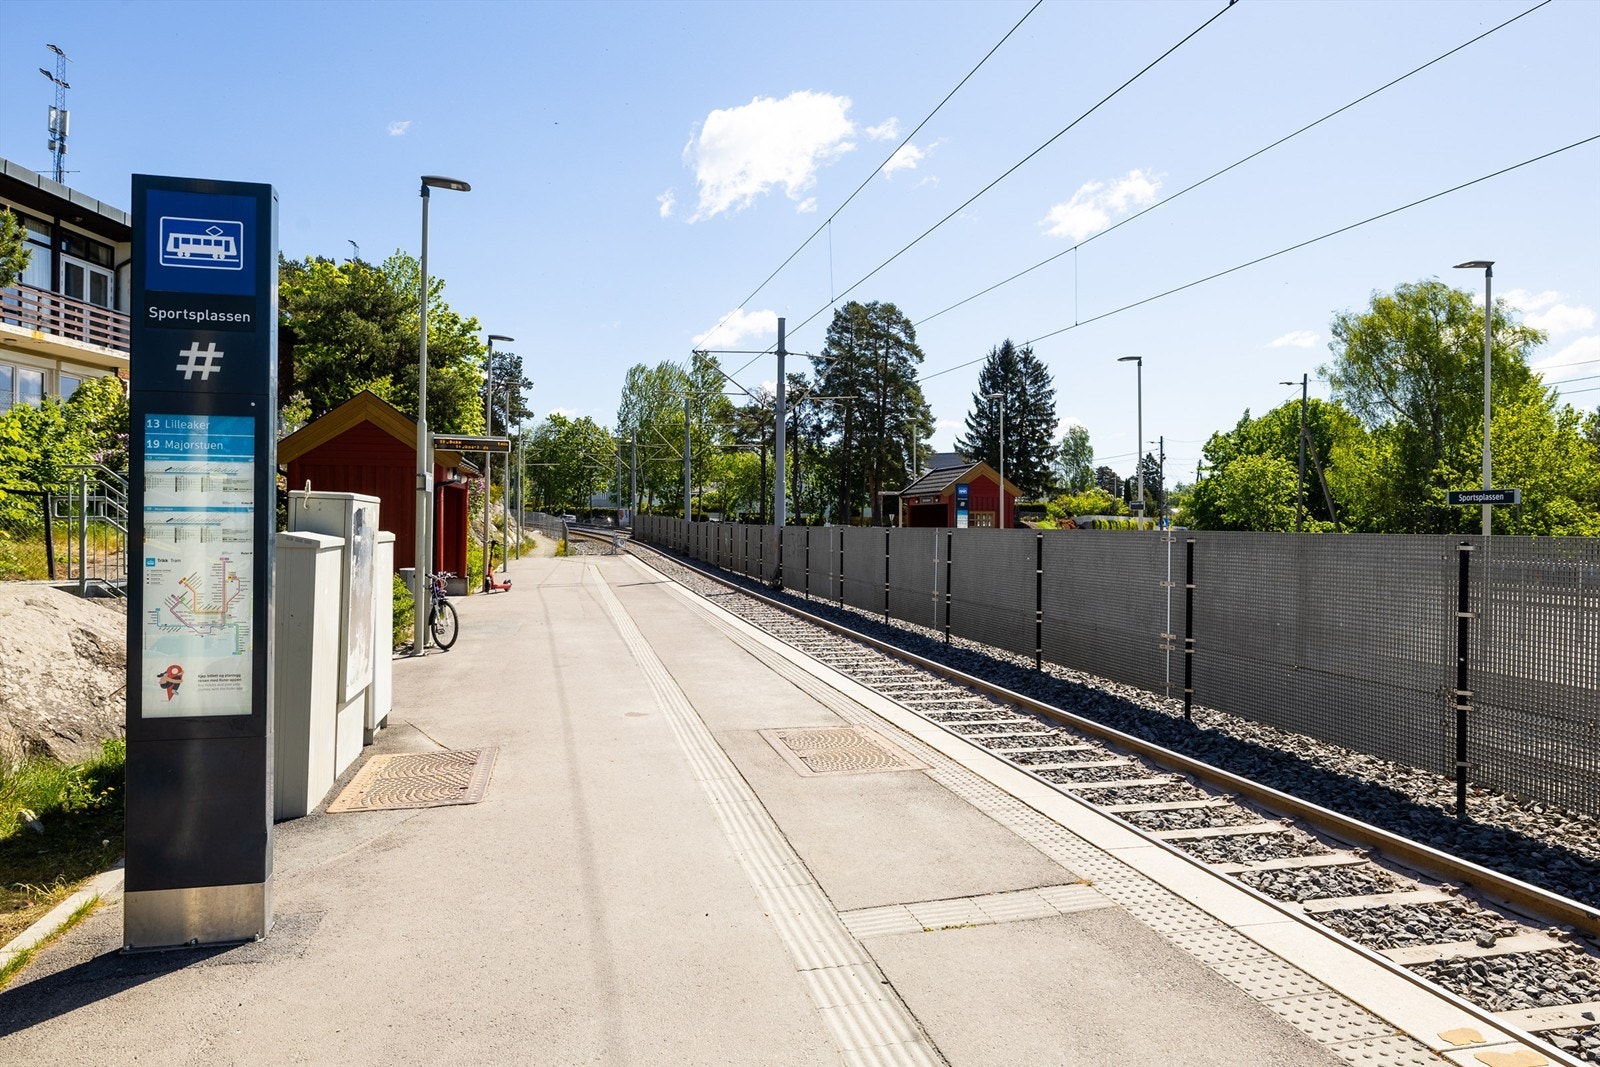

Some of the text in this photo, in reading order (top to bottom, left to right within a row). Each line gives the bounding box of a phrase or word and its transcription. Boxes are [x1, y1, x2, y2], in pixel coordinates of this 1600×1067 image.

[148, 306, 251, 323] Sportsplassen
[146, 419, 210, 430] 13 Lilleaker
[146, 440, 224, 451] 19 Majorstuen
[1458, 493, 1504, 503] Sportsplassen
